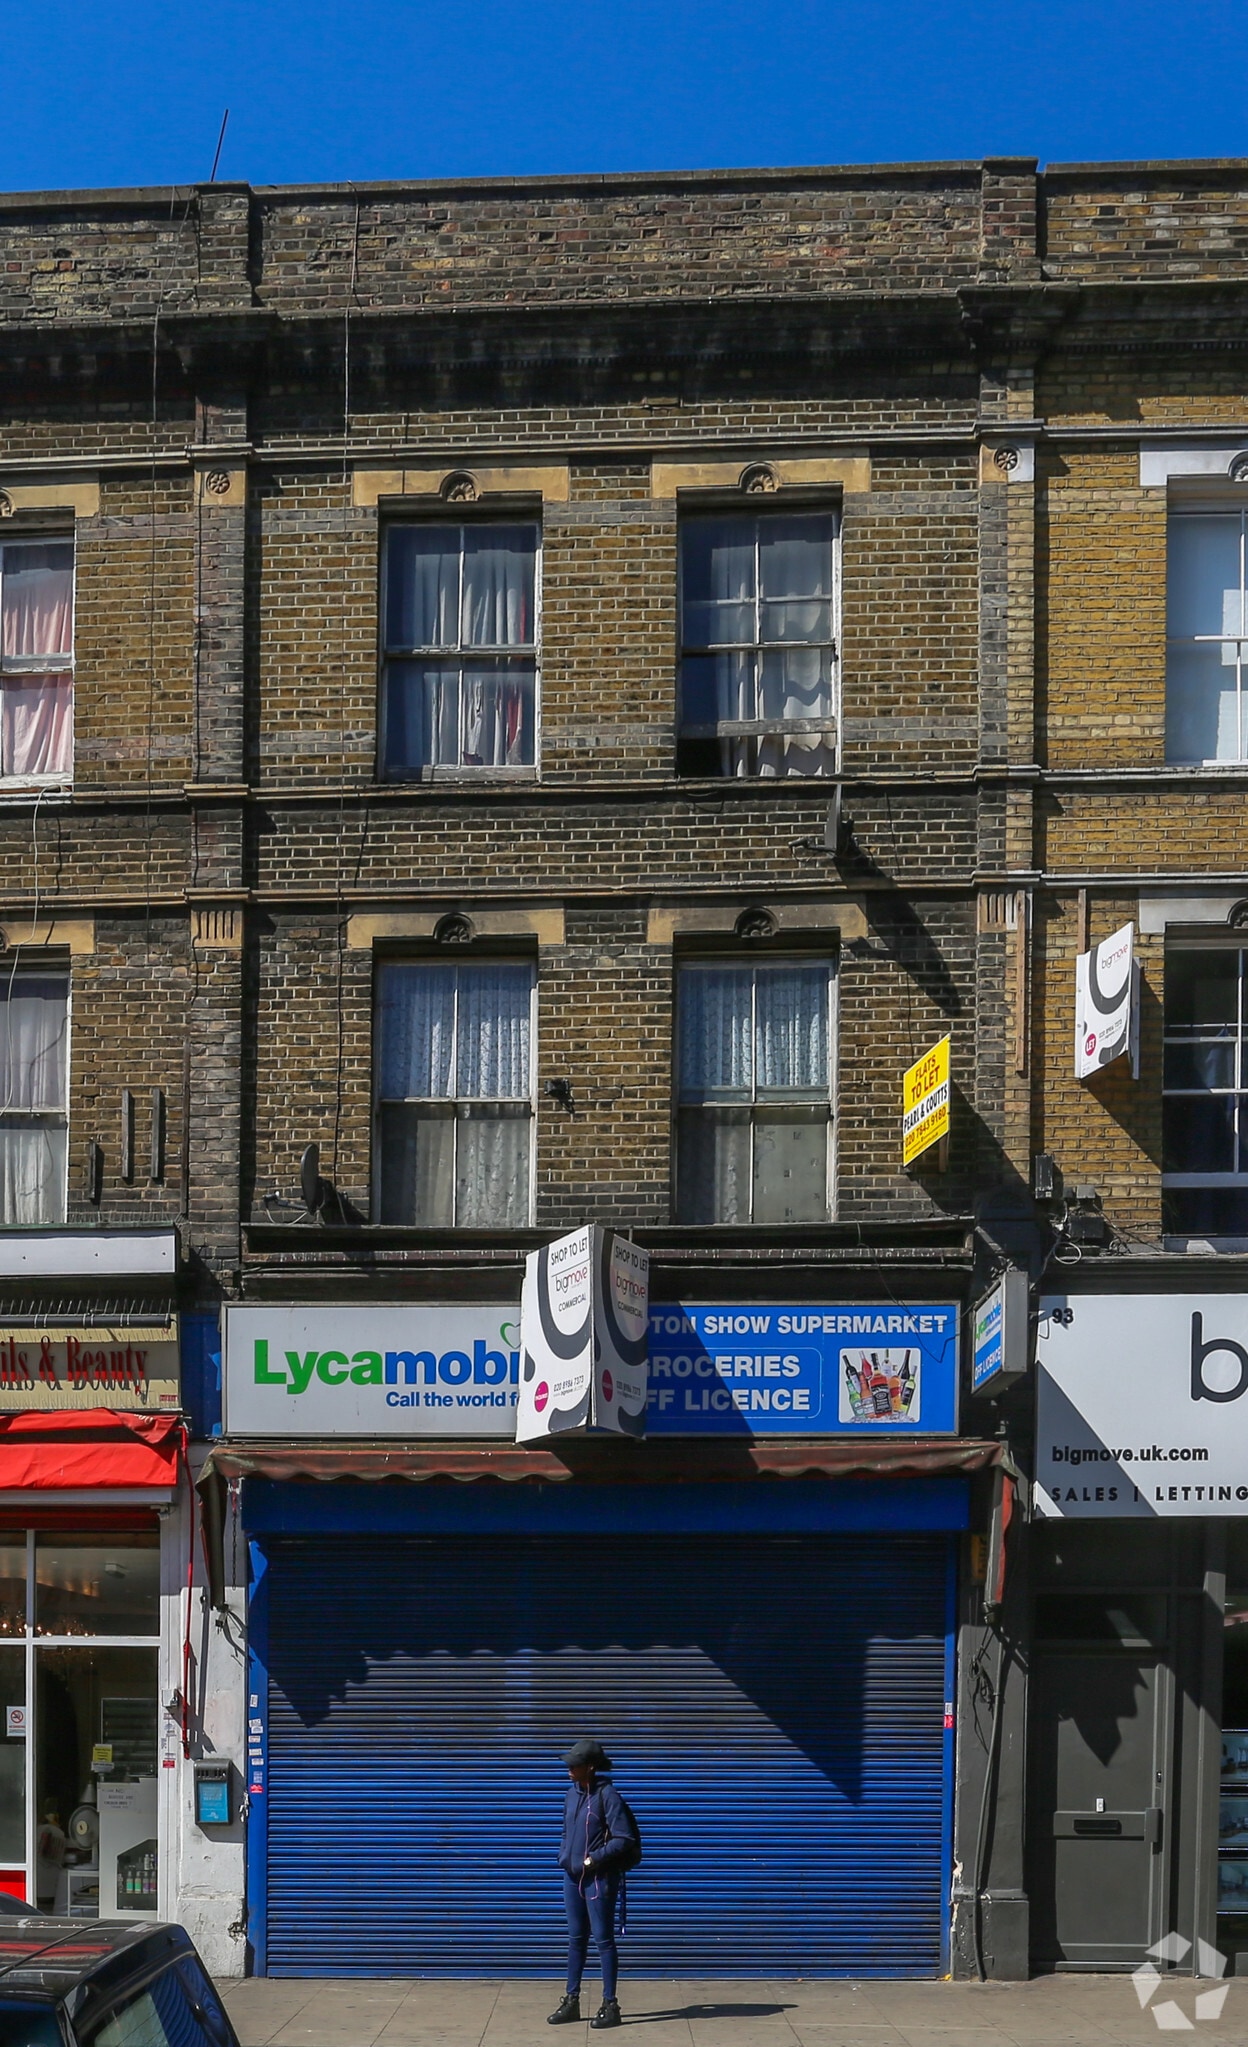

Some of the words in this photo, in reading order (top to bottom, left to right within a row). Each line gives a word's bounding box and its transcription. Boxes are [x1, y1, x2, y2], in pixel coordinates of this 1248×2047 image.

[1086, 1037, 1096, 1052] LET
[915, 1054, 937, 1082] FLATS
[911, 1083, 922, 1102] TO
[924, 1065, 940, 1091] LET
[903, 1110, 919, 1134] PEARL
[920, 1103, 925, 1120] &
[926, 1083, 947, 1113] COUTTS
[905, 1131, 915, 1148] 020
[551, 1246, 567, 1266] SHOP
[569, 1242, 578, 1257] TO
[579, 1236, 588, 1252] LET
[615, 1245, 630, 1264] SHOP
[631, 1253, 639, 1268] TO
[640, 1257, 648, 1272] LET
[556, 1266, 588, 1294] bigmove
[616, 1269, 646, 1298] bigmove
[558, 1292, 587, 1312] COMMERCIAL
[618, 1300, 644, 1319] COMMERCIAL
[649, 1316, 697, 1334] TON
[703, 1315, 770, 1334] SHOW
[777, 1315, 947, 1334] SUPERMARKET
[1052, 1308, 1074, 1324] 93
[39, 1335, 55, 1382] &
[65, 1335, 148, 1396] Beauty
[254, 1339, 520, 1394] Lycamobi
[386, 1391, 423, 1407] Call
[424, 1391, 453, 1407] the
[456, 1391, 508, 1407] world
[646, 1388, 675, 1411] FF
[685, 1388, 810, 1411] LICENCE
[1052, 1445, 1208, 1465] bigmove.uk.com
[1051, 1486, 1118, 1501] SALES
